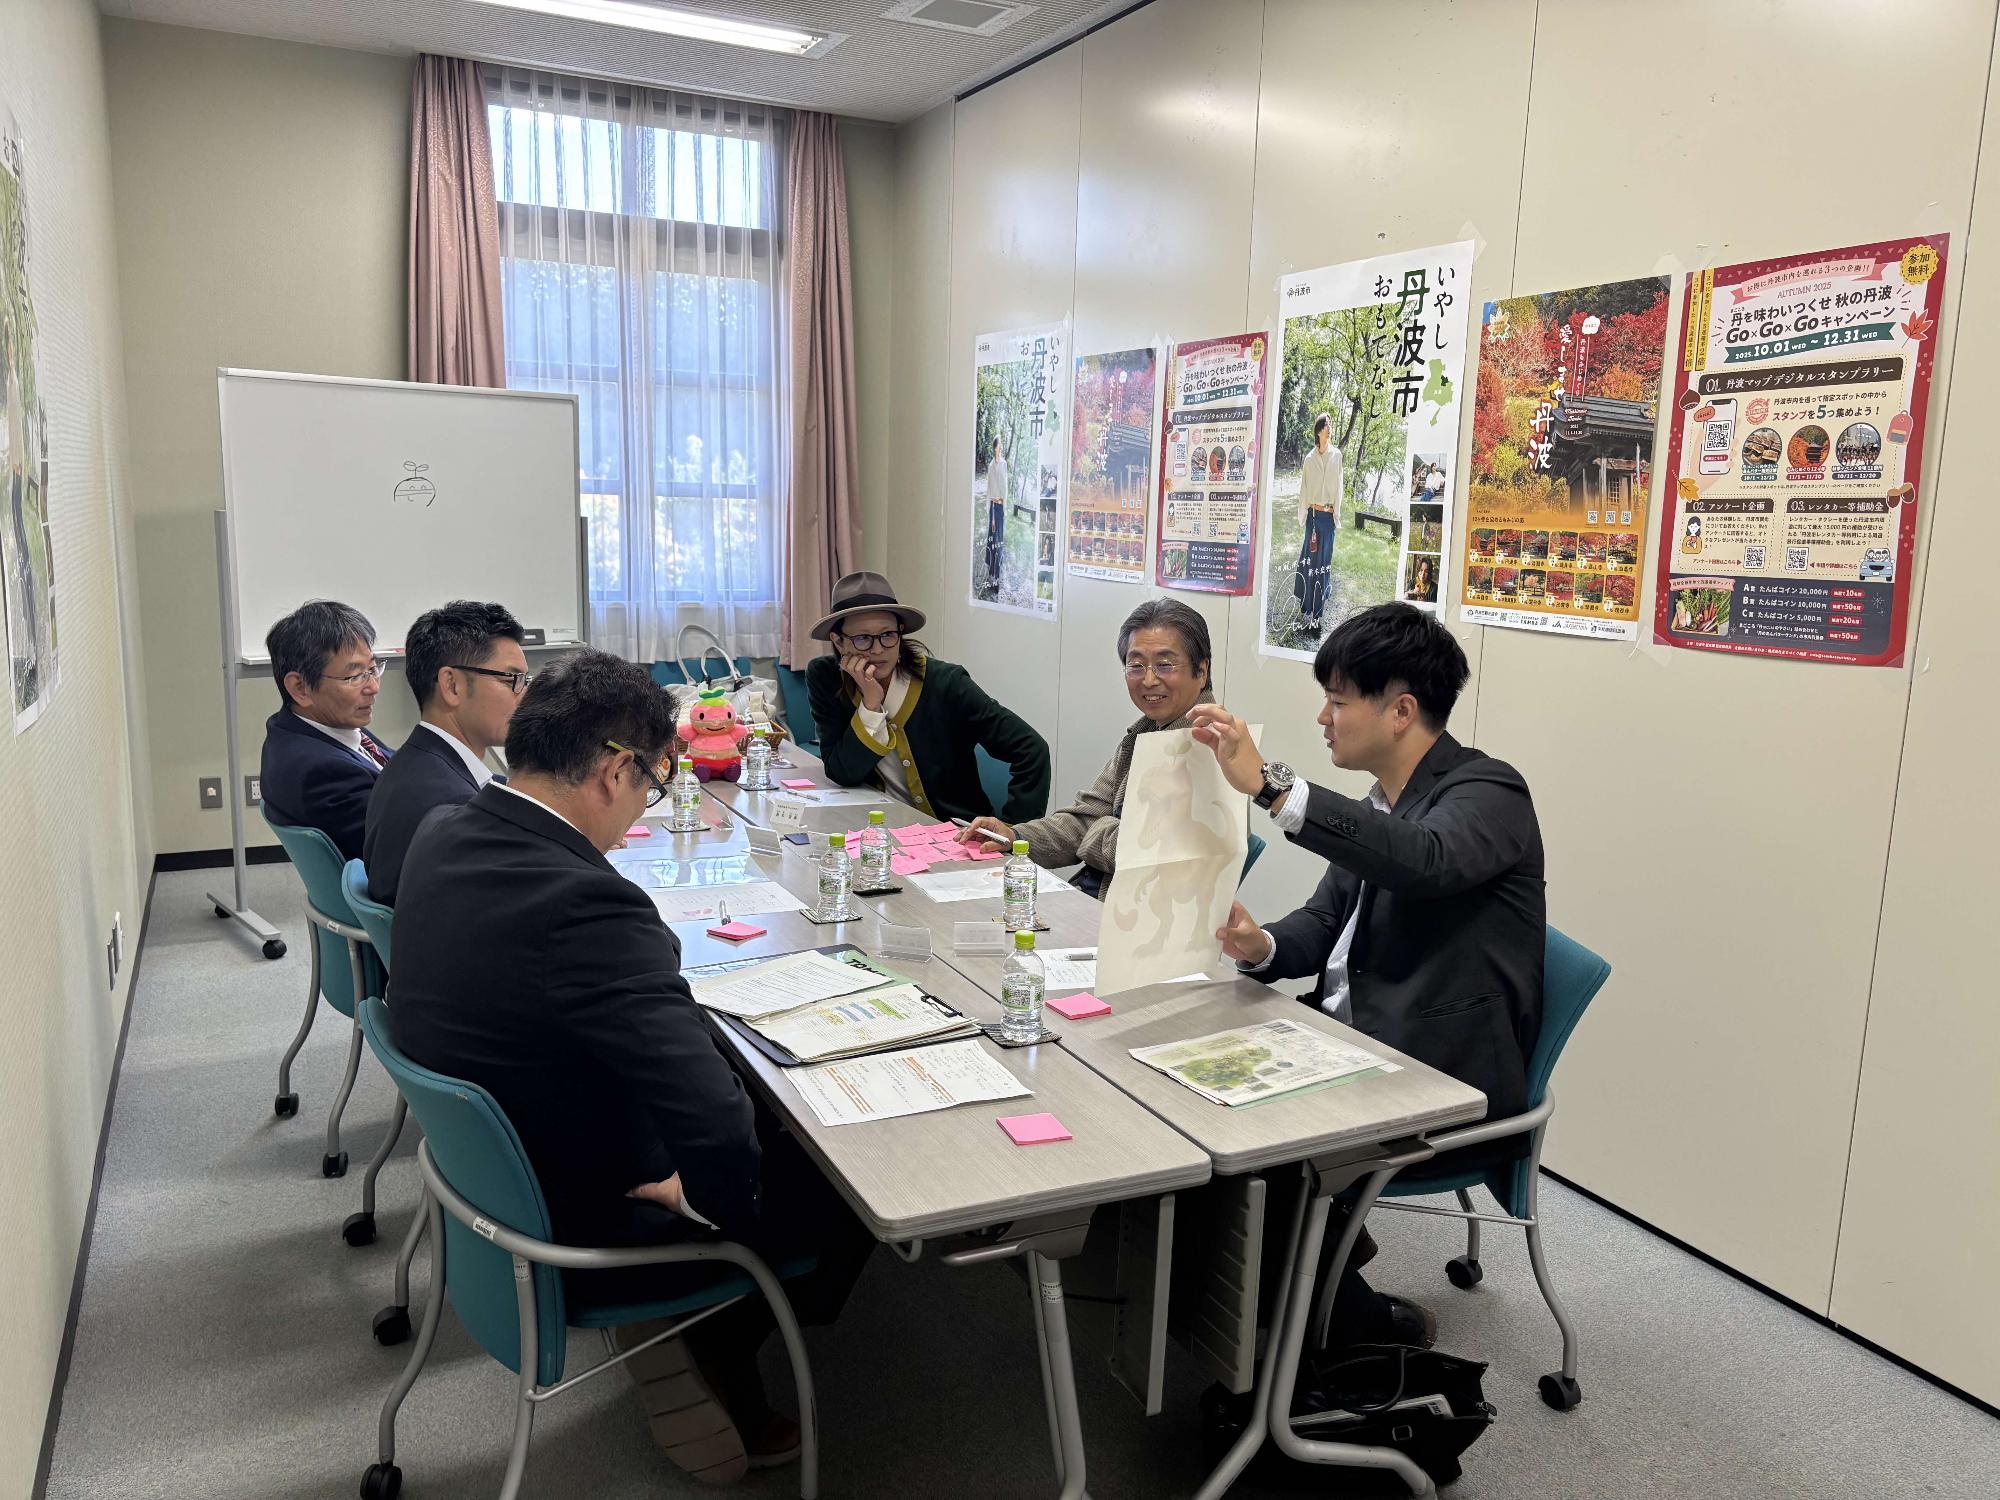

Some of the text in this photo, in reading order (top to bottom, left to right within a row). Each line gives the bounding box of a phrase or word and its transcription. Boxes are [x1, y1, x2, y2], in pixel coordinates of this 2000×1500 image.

[1908, 252, 1931, 265] 参加
[1907, 264, 1930, 277] 無料
[1777, 281, 1832, 299] AUTUMN 2025
[1433, 266, 1455, 350] いやし
[1730, 284, 1893, 327] 丹を味わいつくせ 秋の丹波
[1370, 274, 1393, 419] おもてなし
[1392, 268, 1430, 418] 丹波市
[1791, 342, 1807, 352] WED
[1823, 329, 1860, 346] 12.31
[1861, 331, 1878, 340] WED
[1050, 336, 1060, 394] いやし
[1029, 337, 1048, 440] 丹波市
[1726, 366, 1895, 390] 丹波マップデジタルスタンプラリー
[1528, 401, 1555, 470] 丹波
[1708, 501, 1766, 511] アンケート企画
[1808, 502, 1884, 512] レンタカー等補助金
[1760, 585, 1798, 593] たんばコイン
[1757, 611, 1796, 620] たんばコイン
